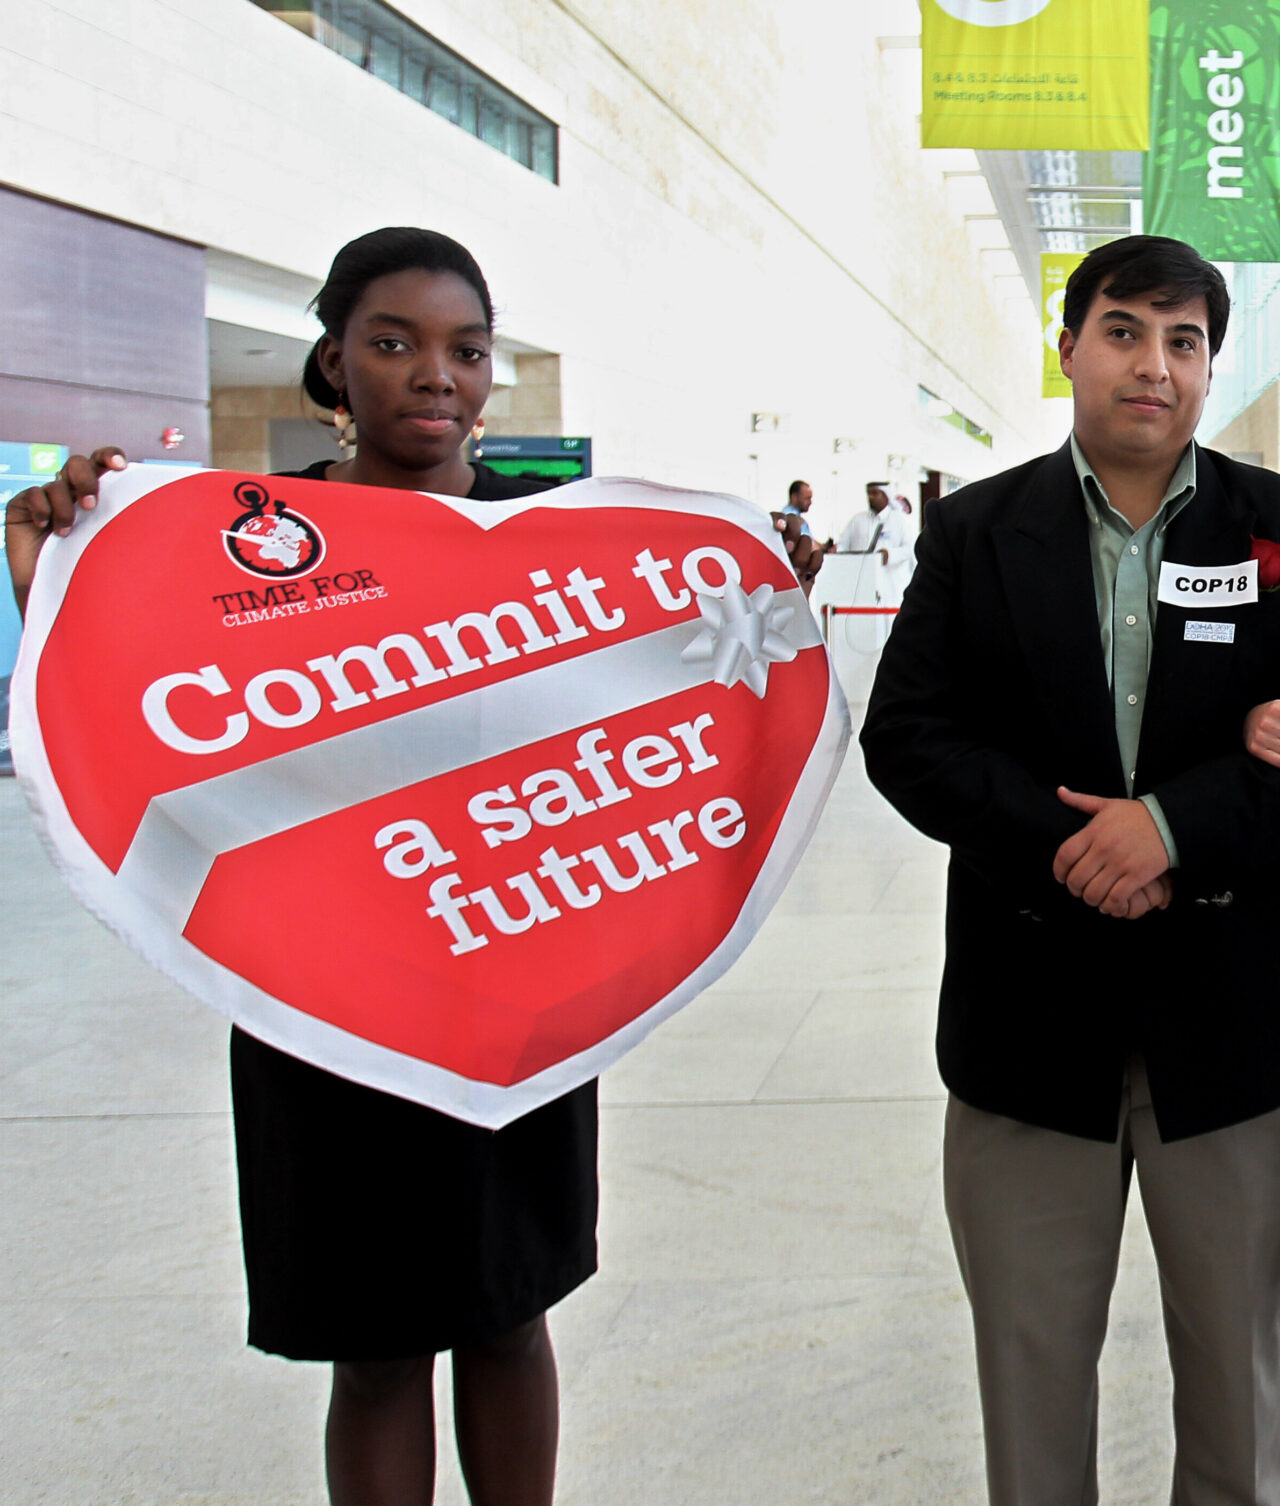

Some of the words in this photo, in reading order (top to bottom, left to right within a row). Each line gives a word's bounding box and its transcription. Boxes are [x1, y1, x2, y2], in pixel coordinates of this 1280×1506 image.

[933, 91, 985, 102] Meeting
[988, 90, 1032, 101] Rooms
[1199, 49, 1245, 199] meet
[212, 582, 305, 614] TIME
[310, 569, 381, 598] FOR
[222, 601, 310, 628] CLIMATE
[314, 586, 388, 611] JUSTICE
[1175, 575, 1248, 593] COP18
[141, 567, 626, 755] Commit
[632, 546, 742, 612] to
[374, 819, 458, 879] a
[467, 712, 720, 849] safer
[427, 797, 746, 956] future
